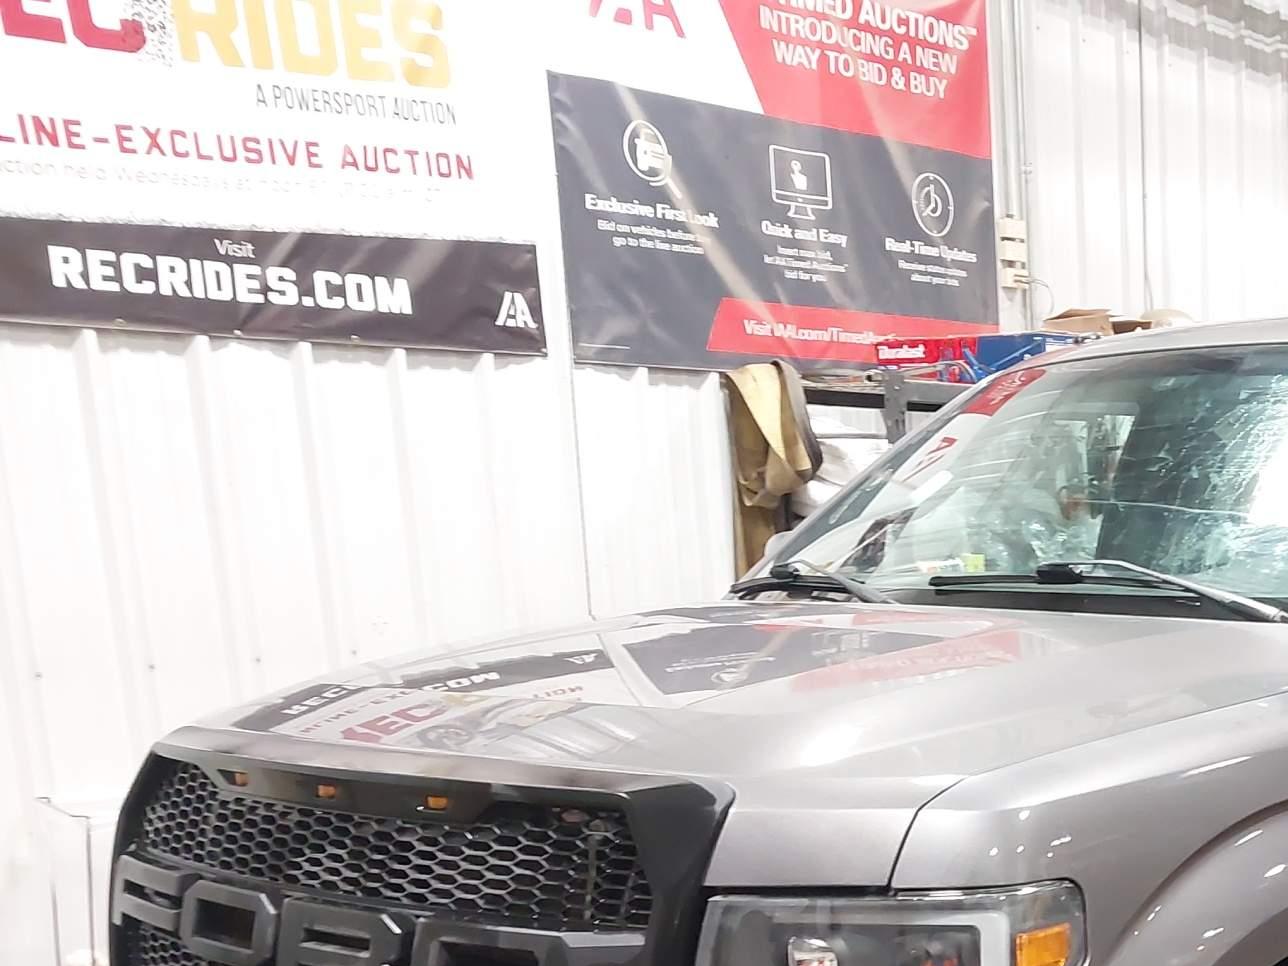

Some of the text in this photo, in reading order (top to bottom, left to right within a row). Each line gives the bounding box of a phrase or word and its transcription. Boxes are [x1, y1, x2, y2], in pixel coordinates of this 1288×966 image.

[171, 0, 451, 88] RIDES
[759, 5, 958, 75] INTRODUCING A NEW
[772, 38, 948, 99] WAY TO BID & BUY
[256, 83, 456, 125] A POWERSPORT AUCTION
[341, 144, 474, 180] AUCTION
[584, 193, 655, 218] Exclusive
[213, 238, 256, 259] Visit
[761, 220, 848, 248] Quick and Easy
[885, 237, 939, 257] Real-Time
[46, 245, 413, 316] RECRIDES.COM
[743, 319, 773, 337] Visit
